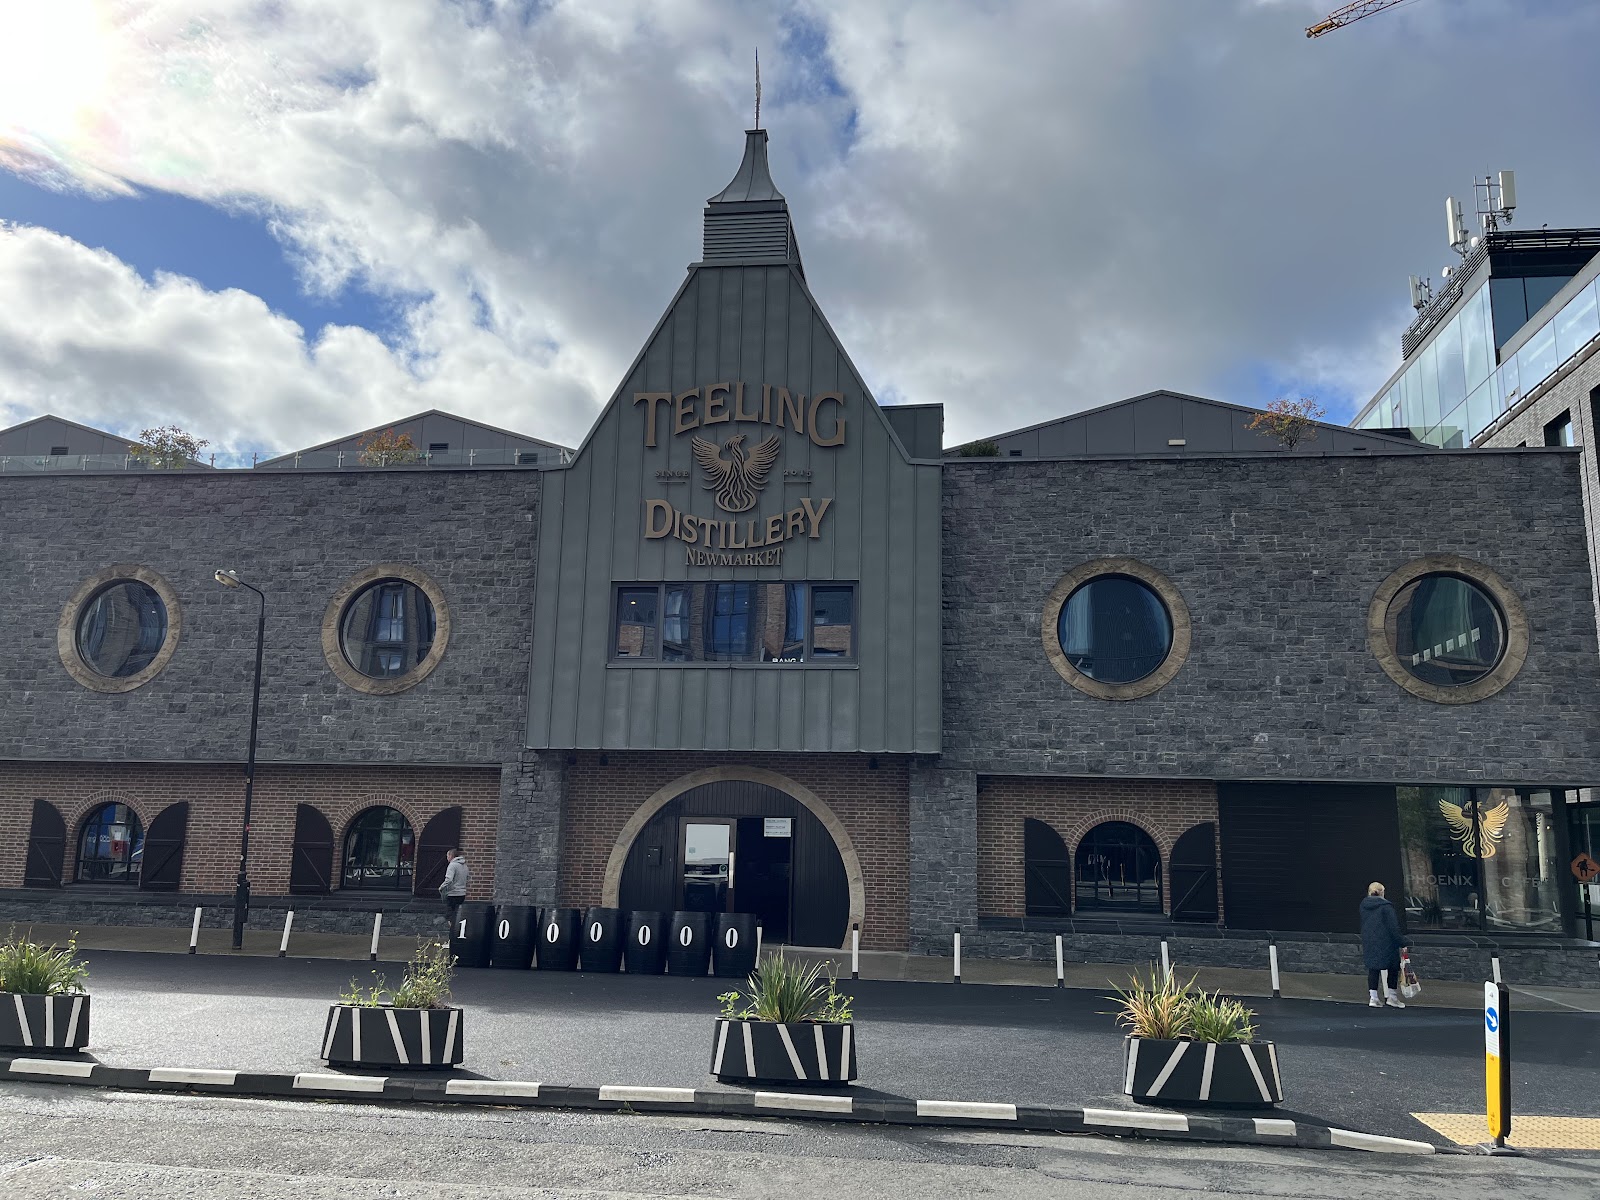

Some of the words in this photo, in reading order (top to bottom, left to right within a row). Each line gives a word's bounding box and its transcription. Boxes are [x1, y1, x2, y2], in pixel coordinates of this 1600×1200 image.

[634, 382, 846, 447] TEELING
[654, 470, 689, 478] SINCE
[644, 498, 833, 549] DISTILLERY
[685, 546, 783, 566] NEWMARKET
[1405, 875, 1473, 886] PHOENIX
[457, 919, 467, 939] 1
[499, 919, 510, 939] 0
[547, 923, 559, 943] 0
[590, 922, 602, 942] 0
[638, 925, 650, 945] 0
[680, 926, 692, 946] 0
[726, 928, 738, 948] 0
